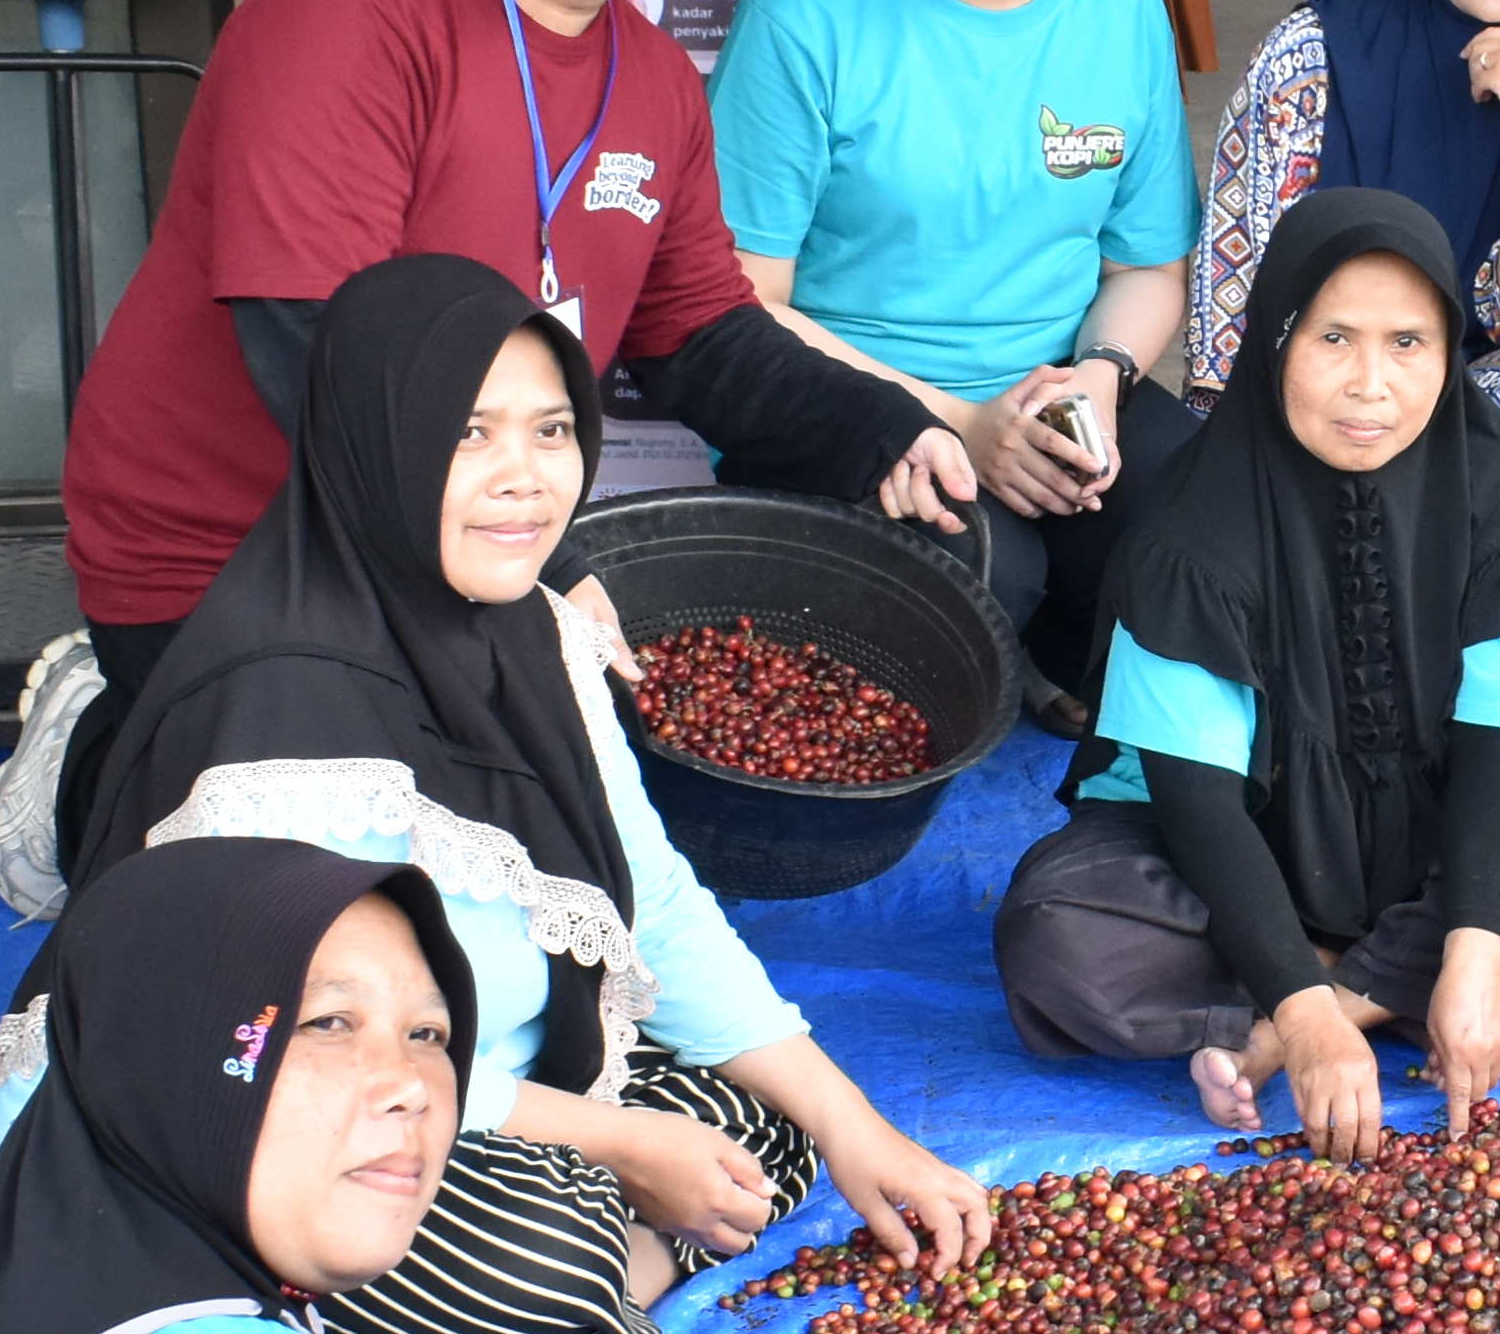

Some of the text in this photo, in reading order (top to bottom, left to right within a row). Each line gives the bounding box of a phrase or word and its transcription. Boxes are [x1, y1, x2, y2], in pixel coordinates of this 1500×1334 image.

[673, 7, 713, 19] kadar
[1046, 150, 1093, 165] KOPI
[603, 154, 652, 177] Learning
[598, 170, 639, 185] beyond
